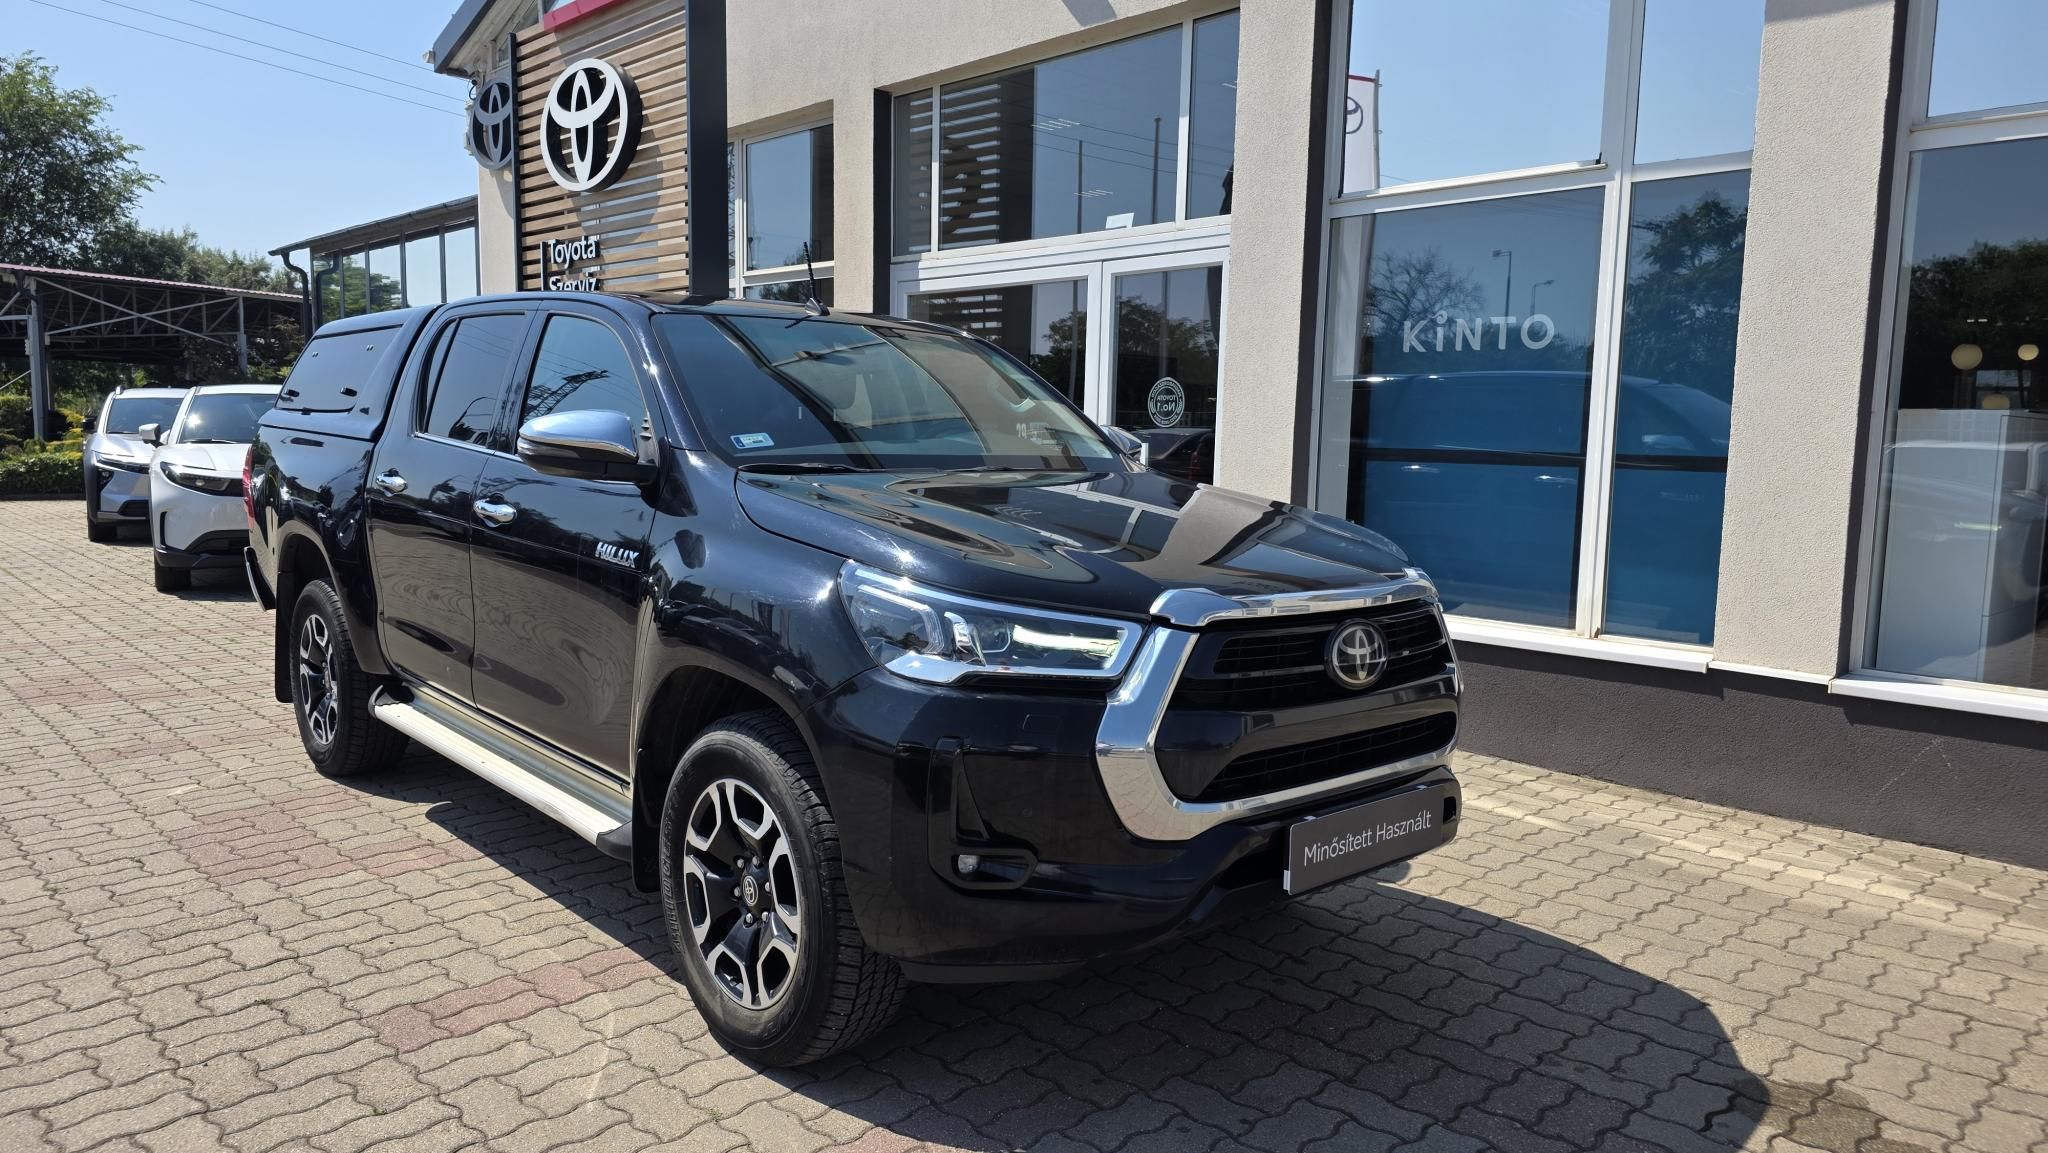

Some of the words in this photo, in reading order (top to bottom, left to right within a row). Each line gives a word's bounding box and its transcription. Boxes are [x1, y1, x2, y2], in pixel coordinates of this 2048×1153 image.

[548, 236, 596, 269] Toyota
[595, 542, 640, 568] HILUX
[1304, 829, 1373, 866] Minősített
[1376, 810, 1432, 843] Használt
